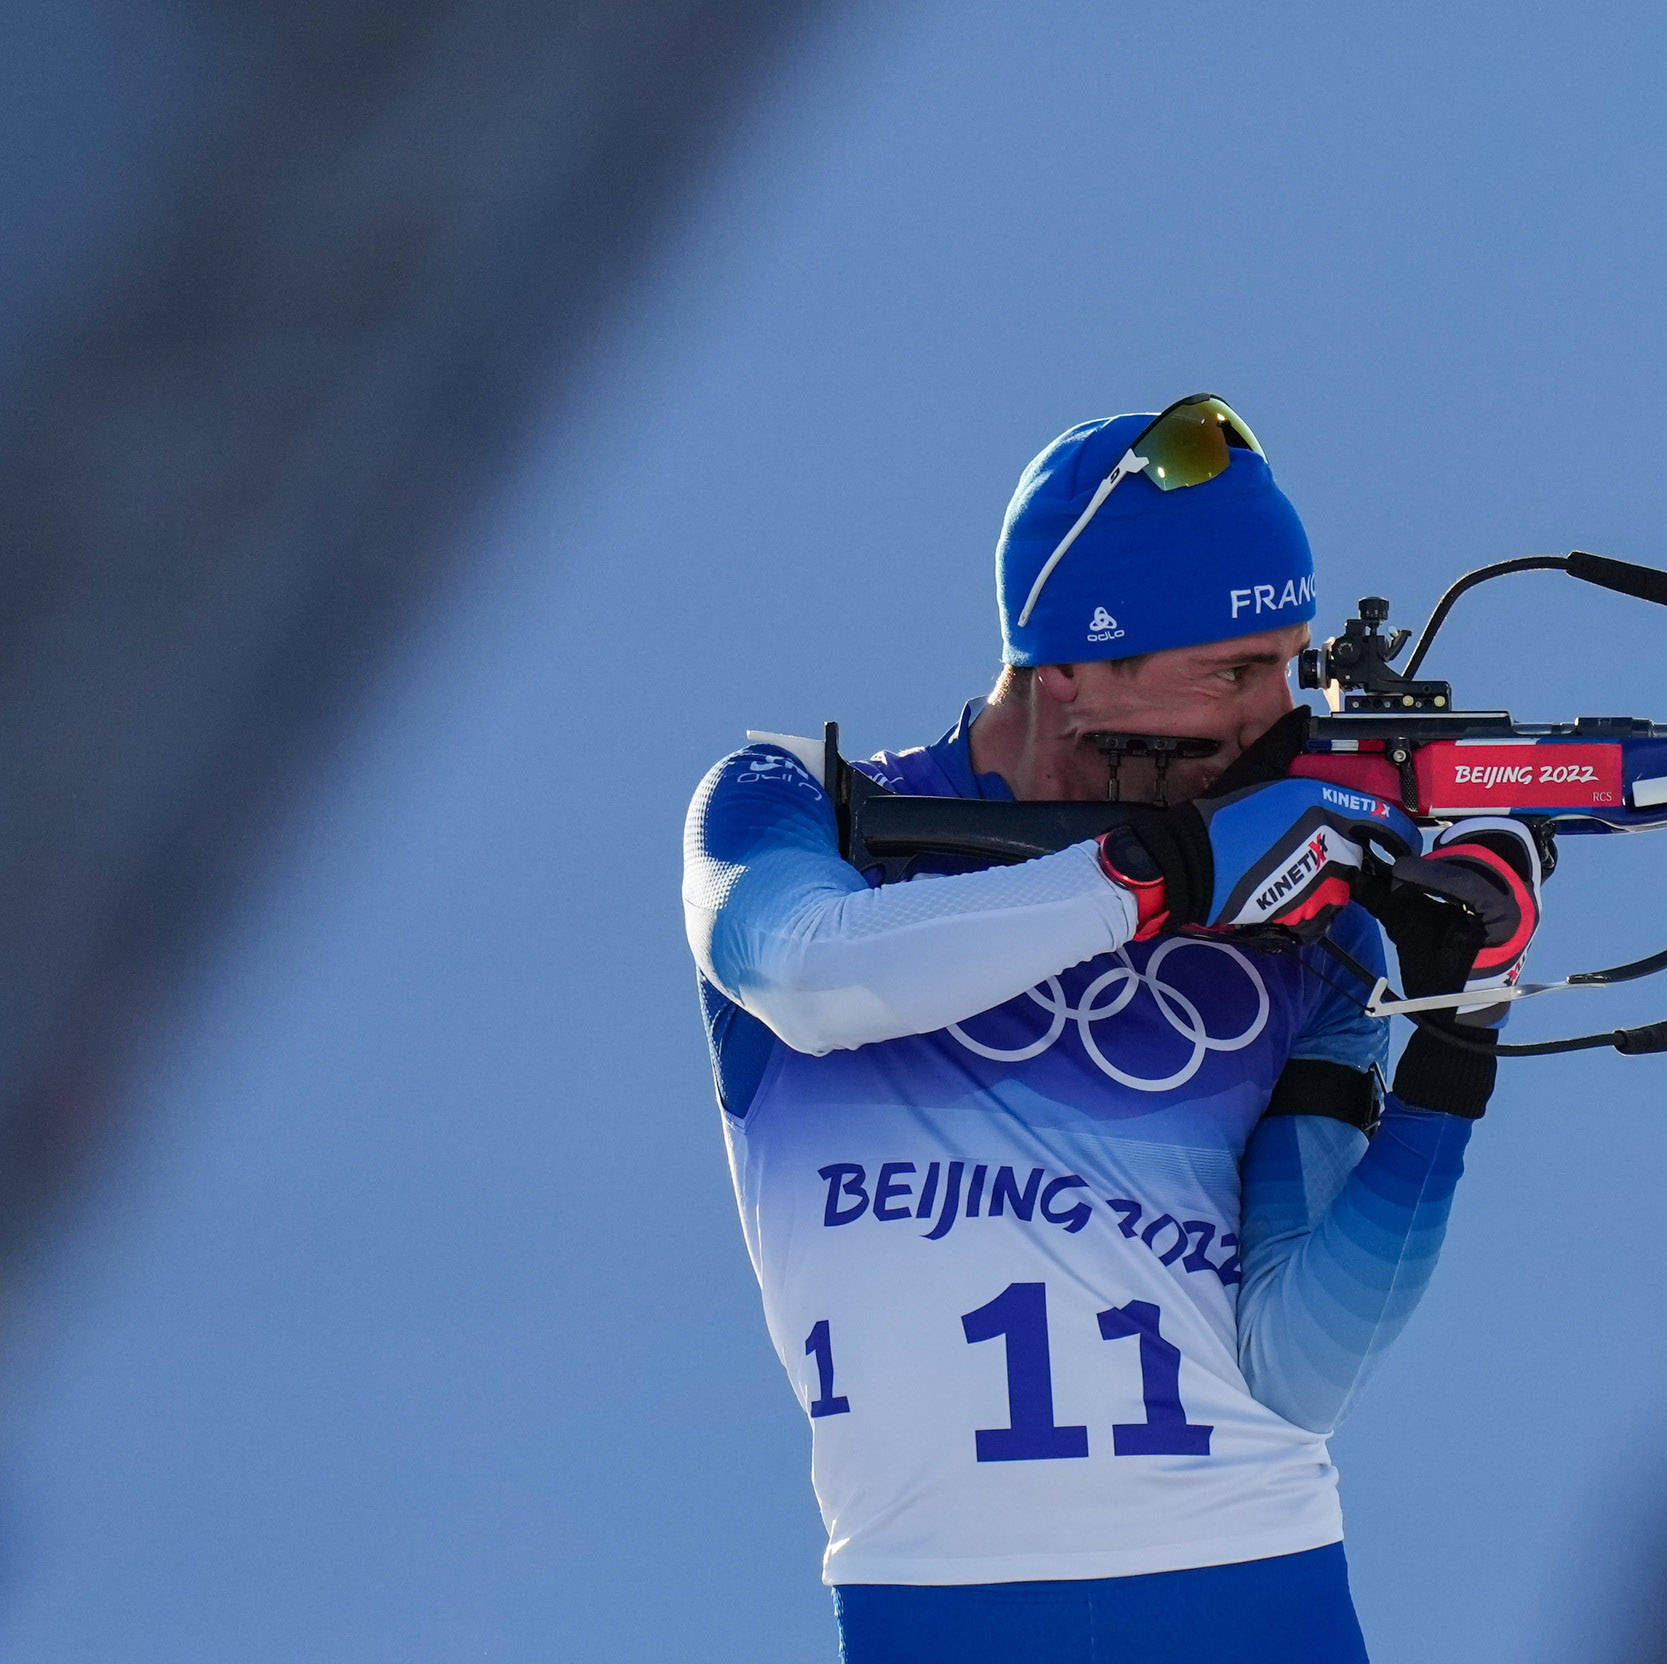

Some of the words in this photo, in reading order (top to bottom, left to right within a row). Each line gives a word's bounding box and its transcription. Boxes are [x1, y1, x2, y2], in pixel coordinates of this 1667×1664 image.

[1230, 573, 1316, 619] FRANC
[1455, 766, 1533, 789] BEIJING
[1539, 765, 1600, 783] 2022
[1593, 791, 1612, 802] RCS
[1322, 787, 1391, 820] KINETIXX
[1256, 832, 1328, 911] KINETIXX
[817, 1161, 1093, 1240] BEIJING
[959, 1281, 1214, 1462] 11
